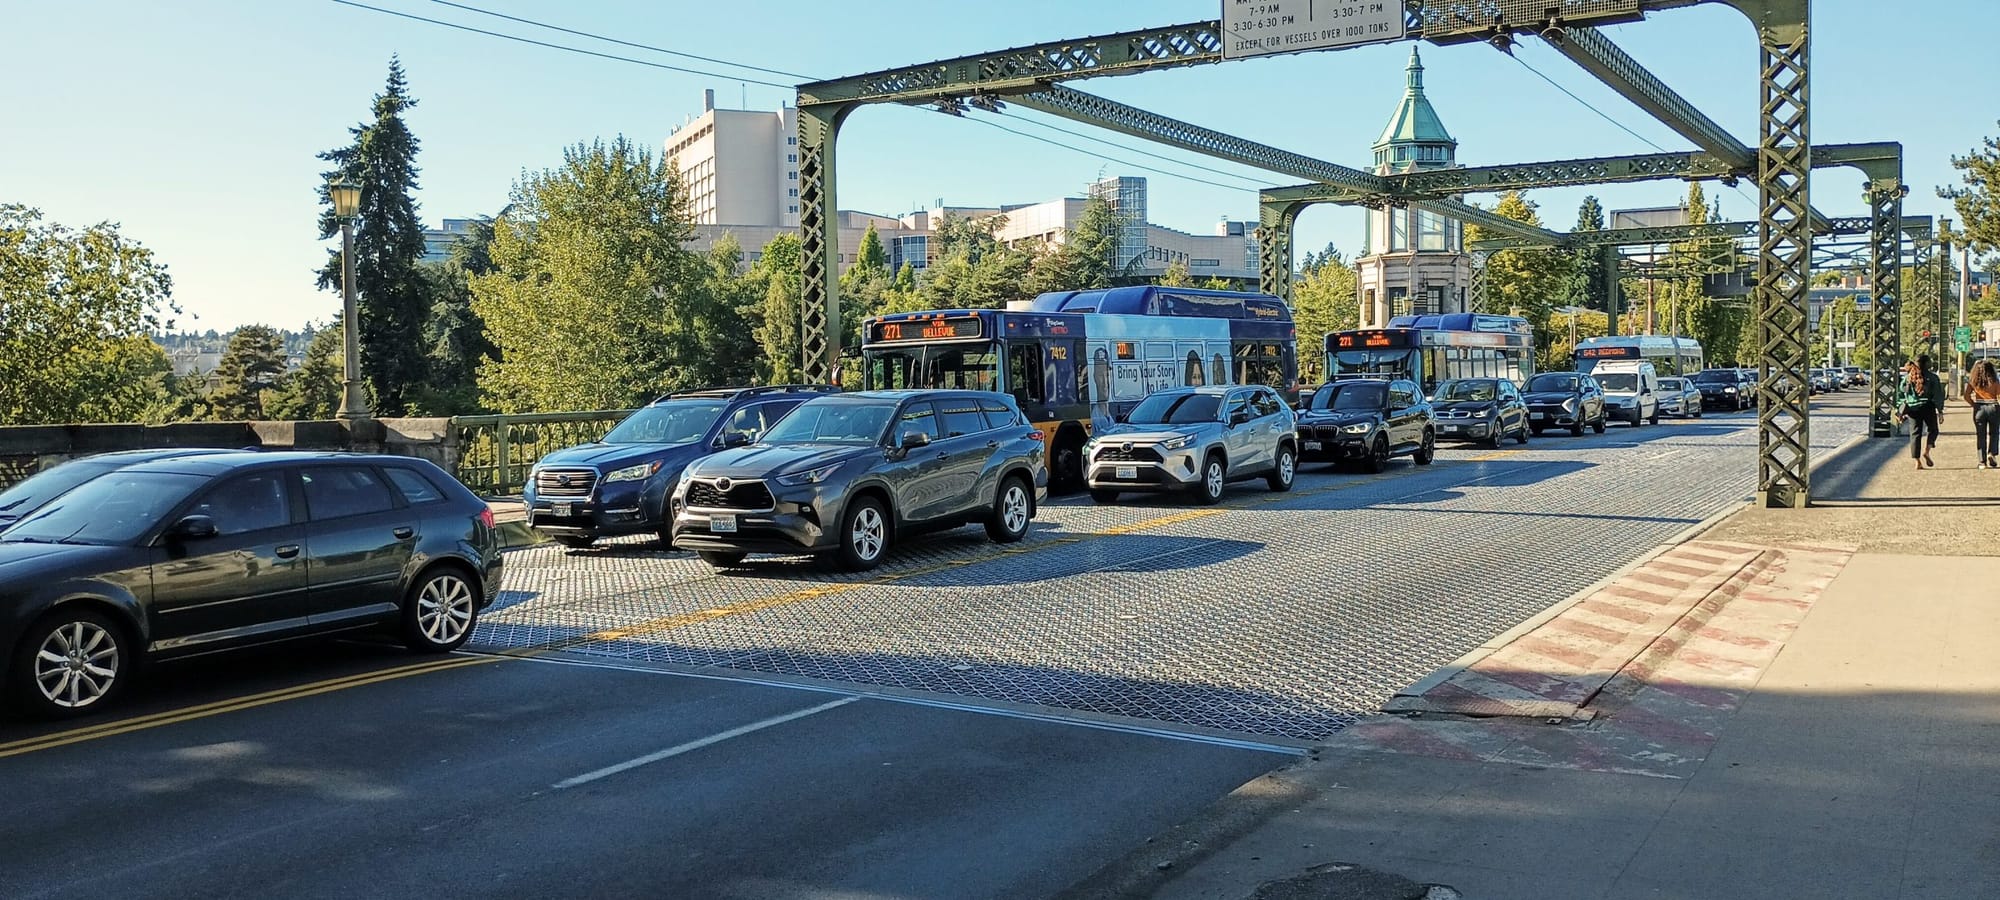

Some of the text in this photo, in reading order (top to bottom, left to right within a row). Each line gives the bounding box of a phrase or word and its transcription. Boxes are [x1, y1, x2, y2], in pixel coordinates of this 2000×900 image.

[1249, 4, 1280, 16] 7-9 AM
[1370, 3, 1383, 14] PM
[1281, 15, 1294, 25] PM
[1236, 22, 1388, 51] EXCEPT FOR VESSELS OVER 1000 TONS
[884, 323, 902, 339] 271
[923, 326, 956, 338] BELLEVUE
[1339, 336, 1353, 346] 271
[1050, 346, 1067, 360] 7412
[1117, 364, 1175, 382] Bring Your Story
[1156, 379, 1169, 391] Life
